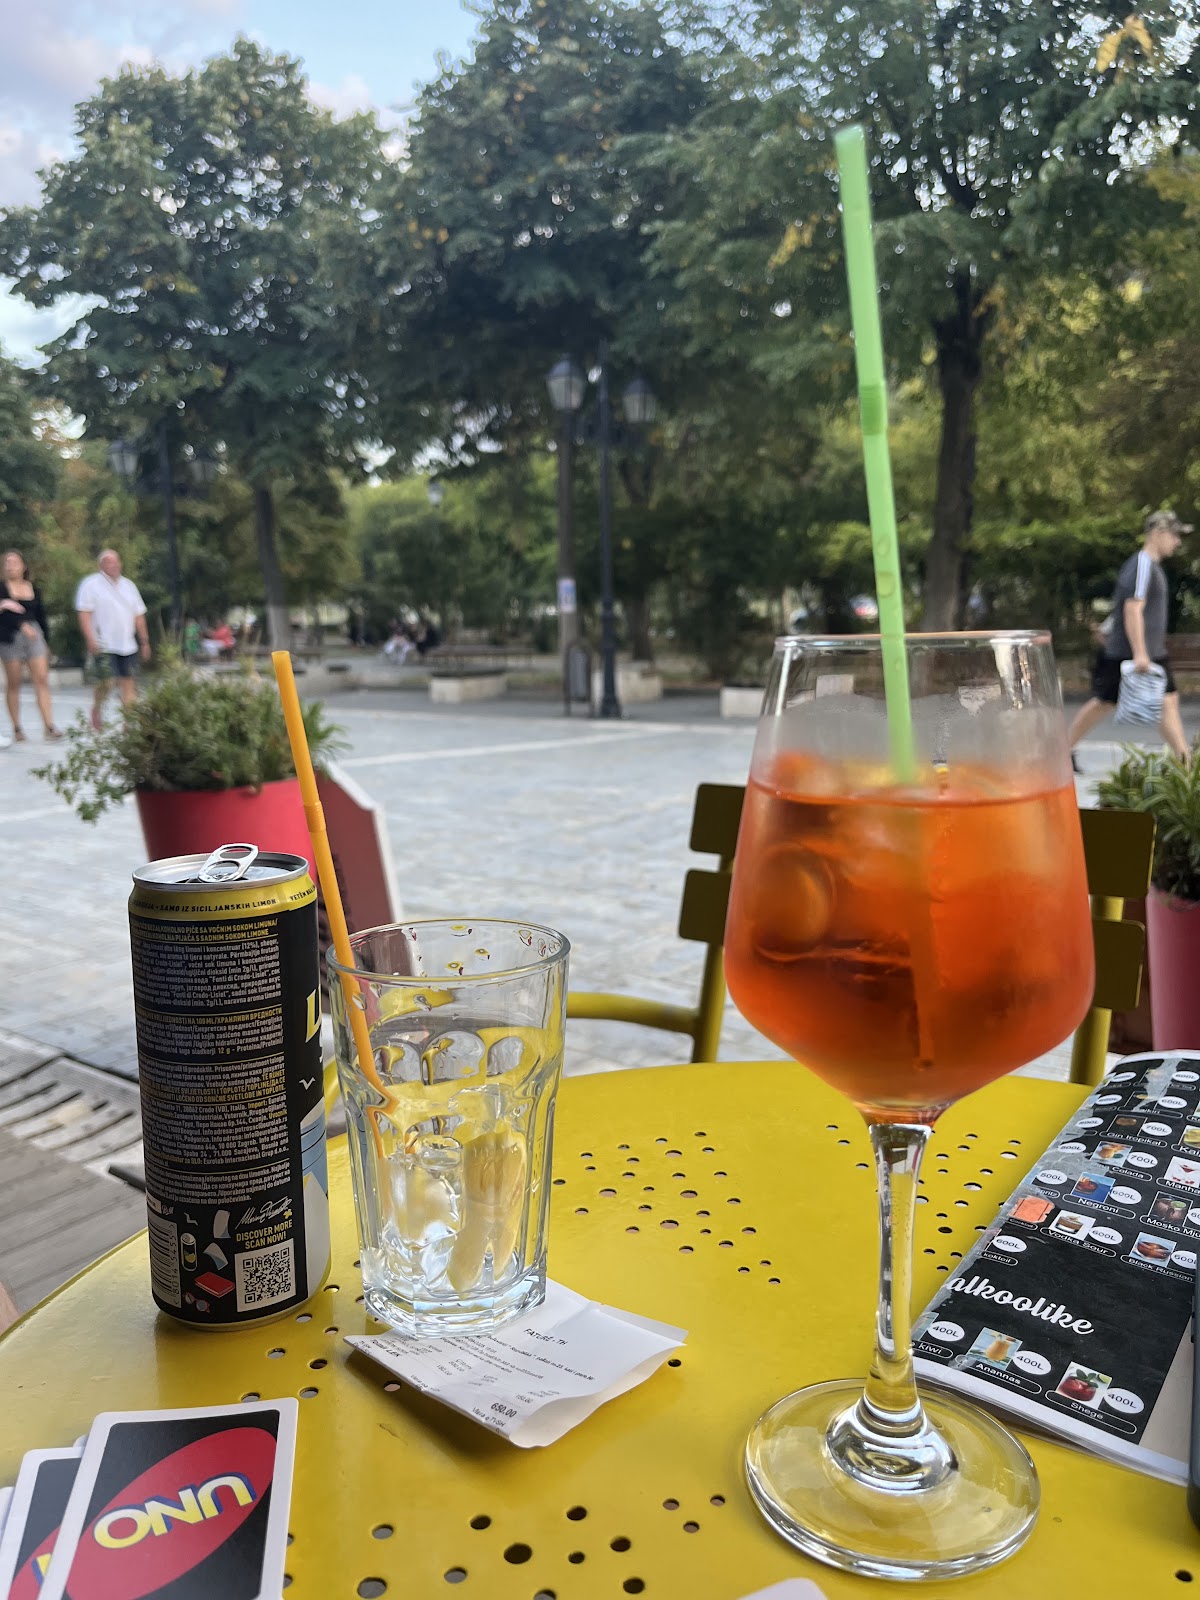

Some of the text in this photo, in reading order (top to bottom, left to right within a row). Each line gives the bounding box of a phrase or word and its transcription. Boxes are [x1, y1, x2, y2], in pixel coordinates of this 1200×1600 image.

[160, 904, 180, 912] SAMO
[232, 922, 253, 932] SOKOM
[225, 932, 246, 940] SOKOM
[1146, 1124, 1168, 1133] 700L
[1130, 1153, 1156, 1165] 700L
[1112, 1166, 1145, 1179] Colada
[1112, 1190, 1136, 1201] 600L
[1078, 1198, 1119, 1214] Negroni
[236, 1219, 293, 1243] DISCOVER MORE
[1146, 1217, 1180, 1232] Mosko
[245, 1231, 287, 1250] SCAN NOW!
[1048, 1229, 1110, 1254] Vodka Sour
[1092, 1230, 1116, 1242] 600L
[996, 1238, 1020, 1250] 600L
[1128, 1259, 1193, 1282] Black Russian
[945, 1275, 1095, 1335] alkoolike
[932, 1325, 959, 1338] 400L
[918, 1342, 942, 1354] kiwi
[1016, 1355, 1044, 1371] 400L
[975, 1362, 1021, 1384] Anannas
[1108, 1393, 1137, 1409] 400L
[490, 1402, 517, 1418] 650.00
[1071, 1402, 1104, 1420] Shege
[93, 1472, 257, 1549] UNO
